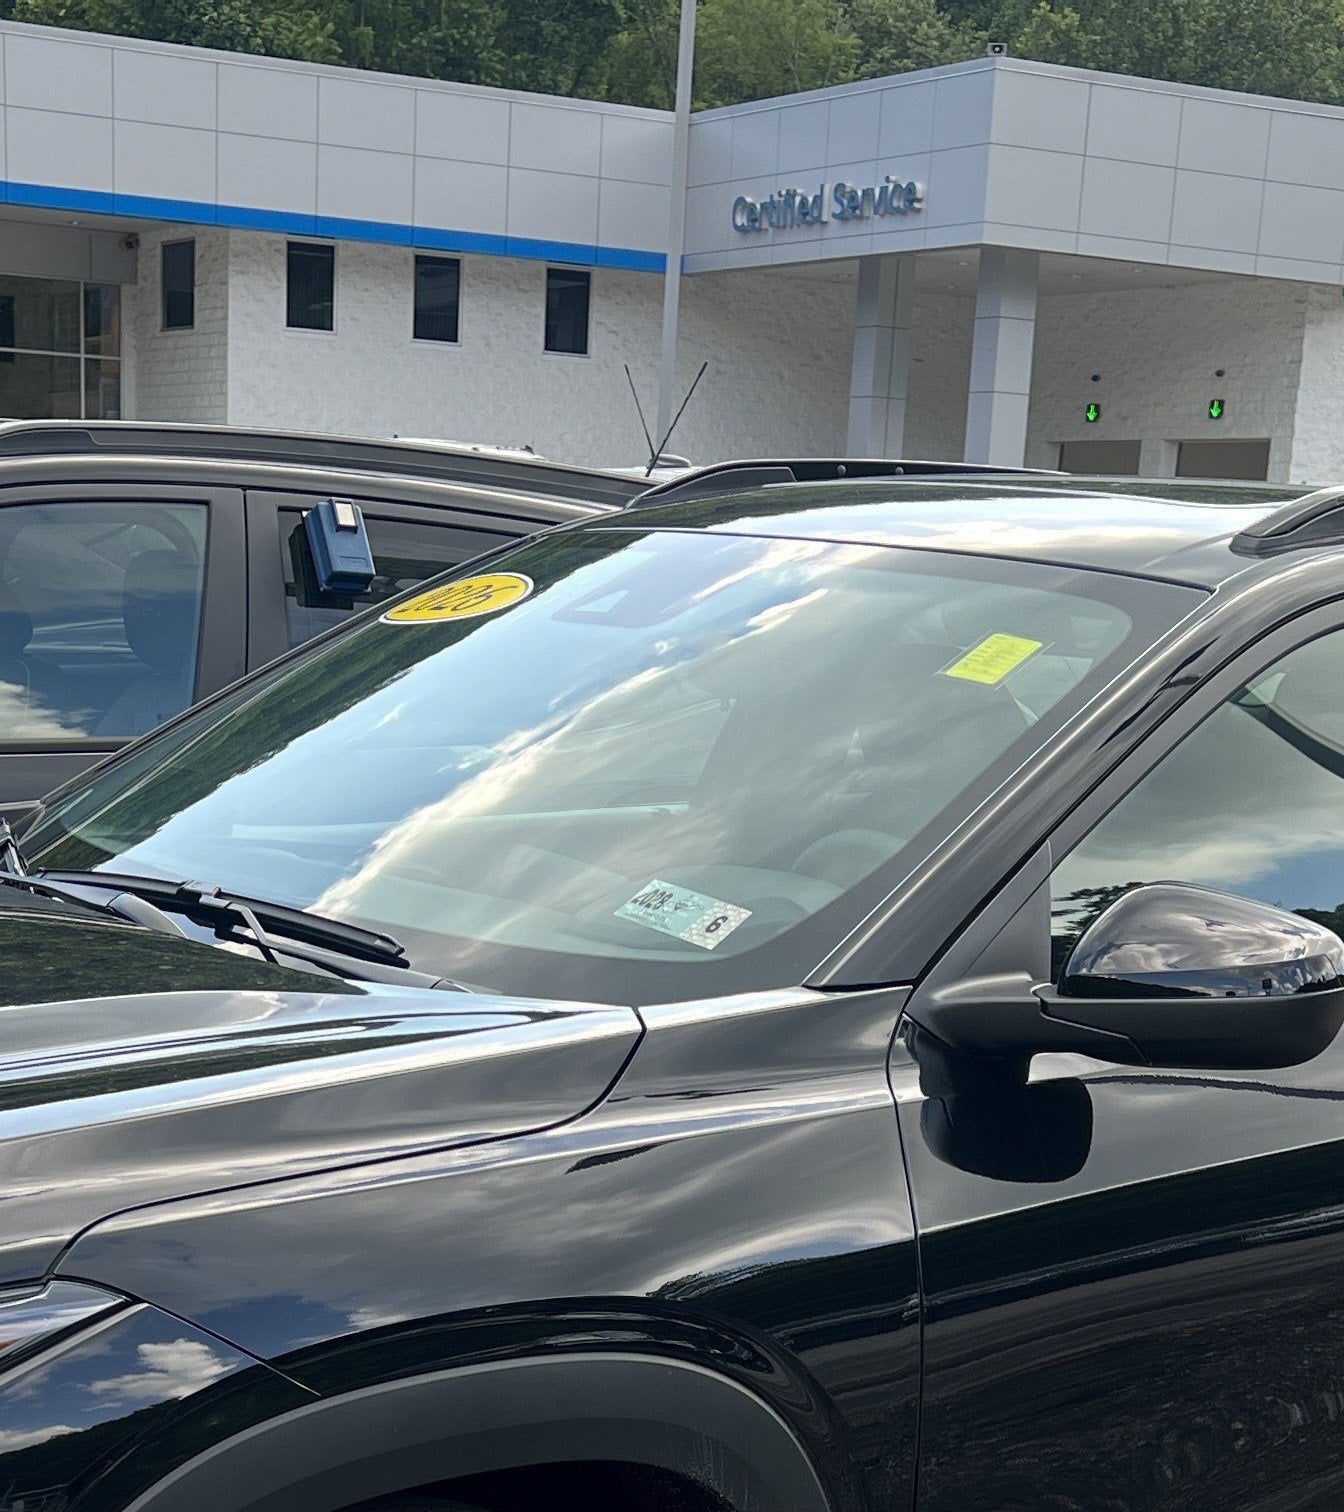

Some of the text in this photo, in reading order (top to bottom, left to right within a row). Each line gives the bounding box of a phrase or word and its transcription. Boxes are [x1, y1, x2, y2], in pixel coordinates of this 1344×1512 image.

[732, 175, 924, 233] Certified Service
[705, 915, 729, 934] 6
